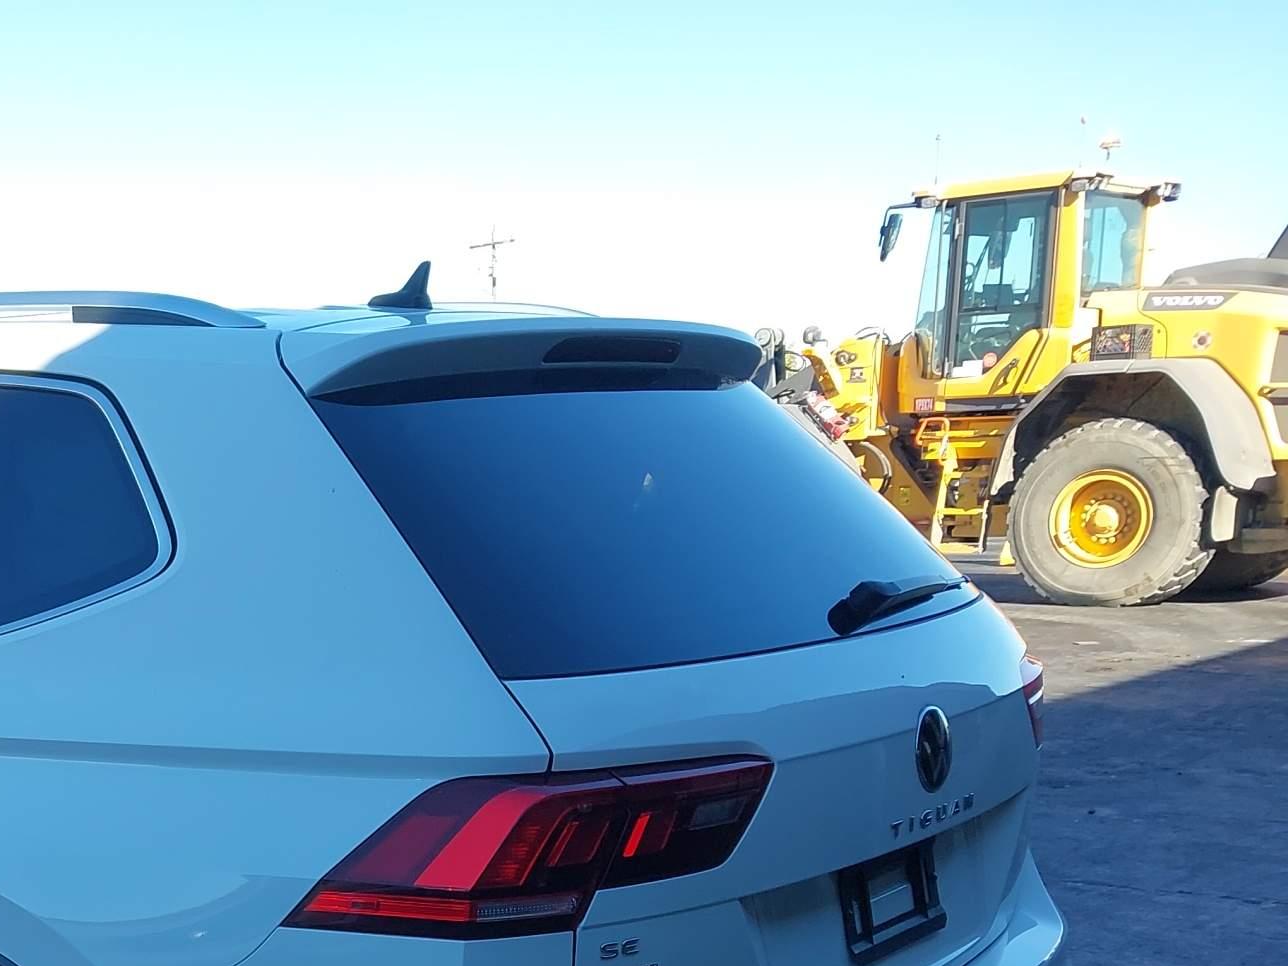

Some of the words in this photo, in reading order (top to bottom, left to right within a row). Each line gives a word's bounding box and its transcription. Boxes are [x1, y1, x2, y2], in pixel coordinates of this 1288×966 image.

[1151, 295, 1225, 307] VOLVO
[889, 792, 976, 839] TIGUAN
[599, 937, 641, 960] SE
